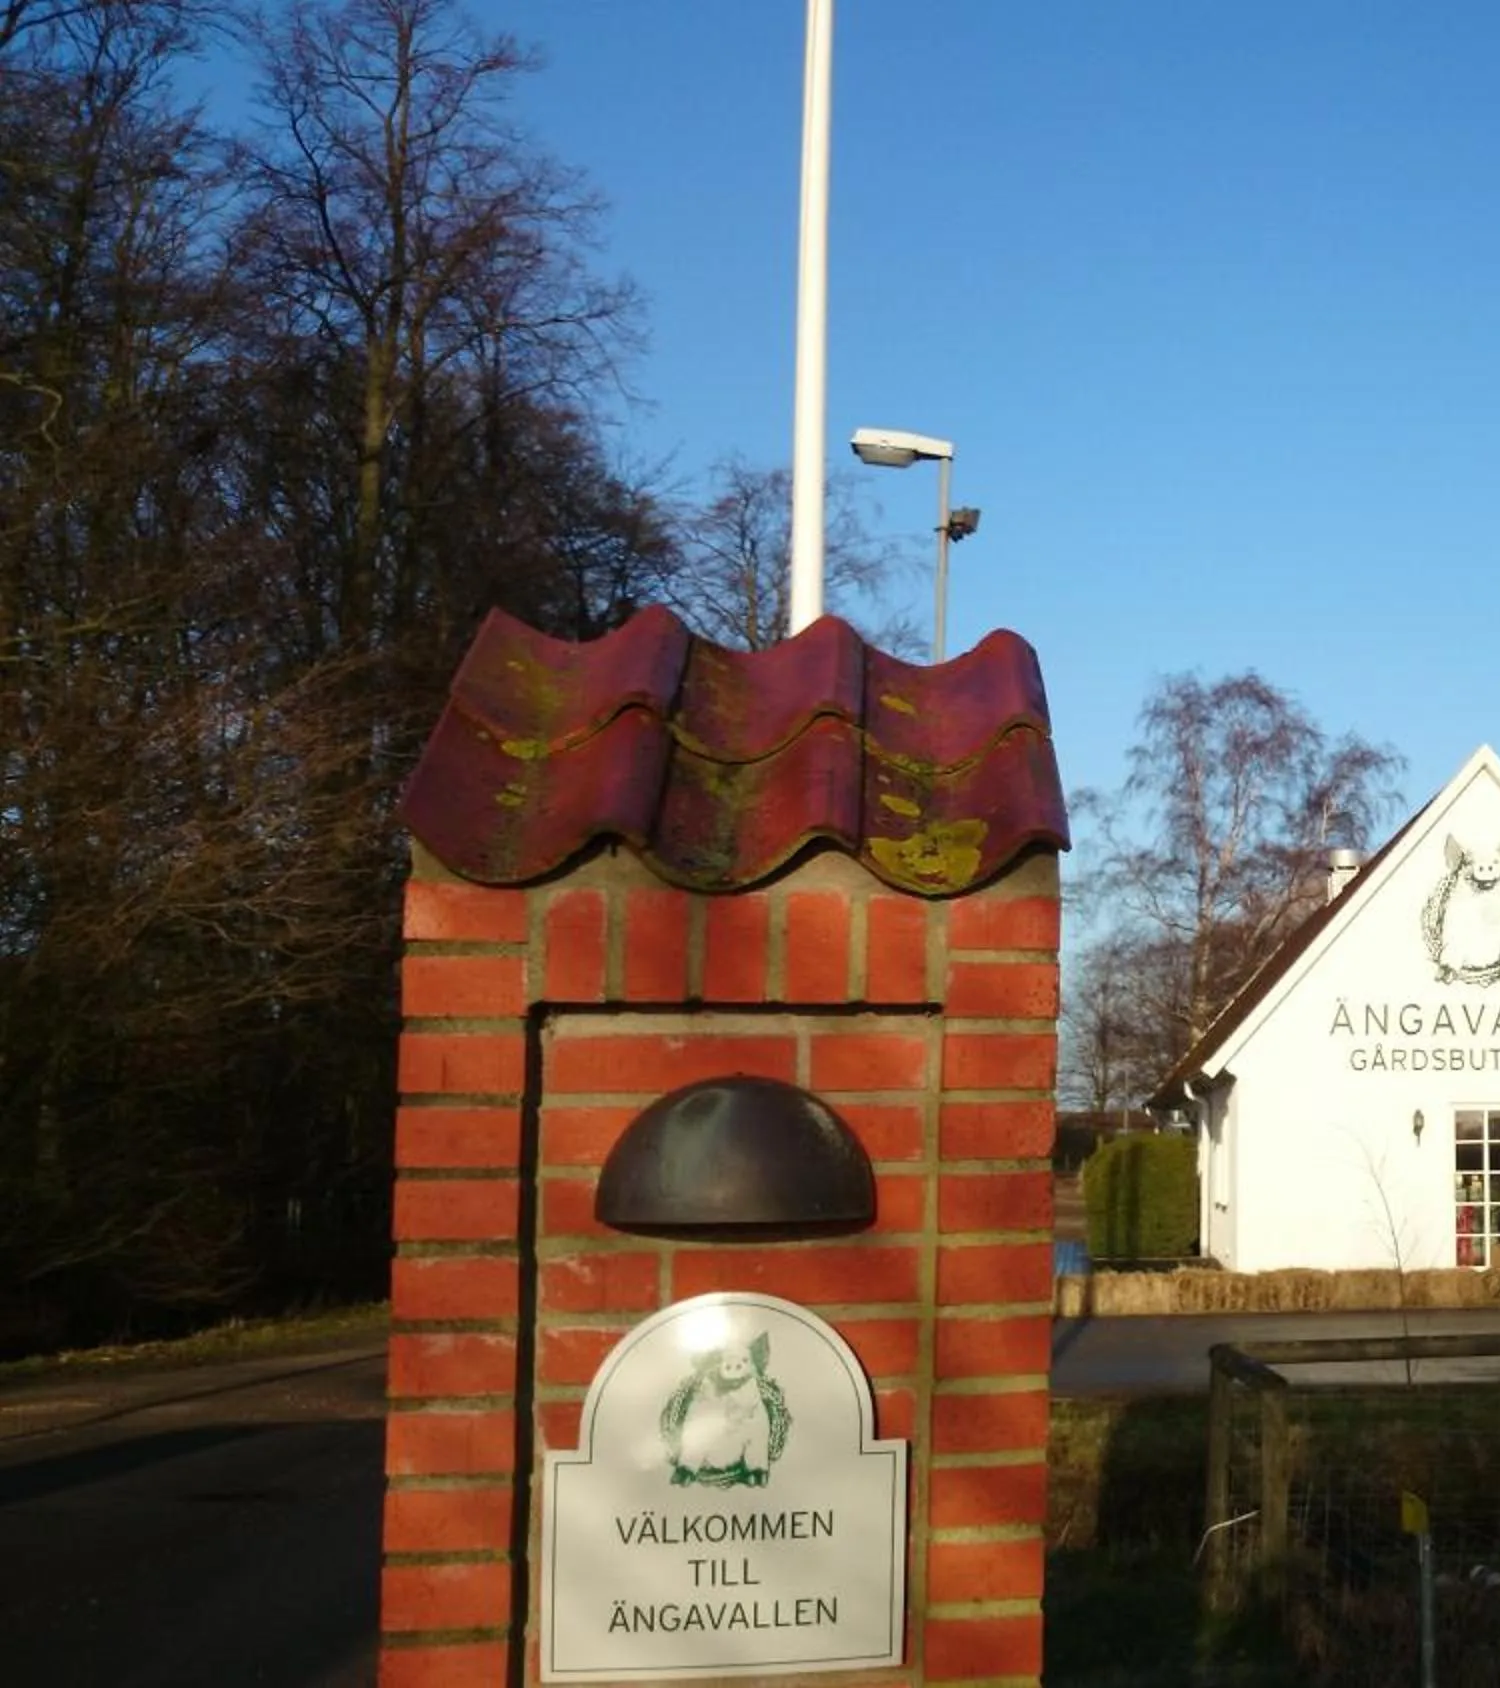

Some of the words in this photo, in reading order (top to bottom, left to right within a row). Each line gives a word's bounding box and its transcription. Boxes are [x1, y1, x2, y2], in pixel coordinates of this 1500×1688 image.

[615, 1509, 834, 1545] VÄLKOMMEN
[687, 1557, 761, 1588] TILL
[607, 1596, 839, 1634] ÄNGAVALLEN
